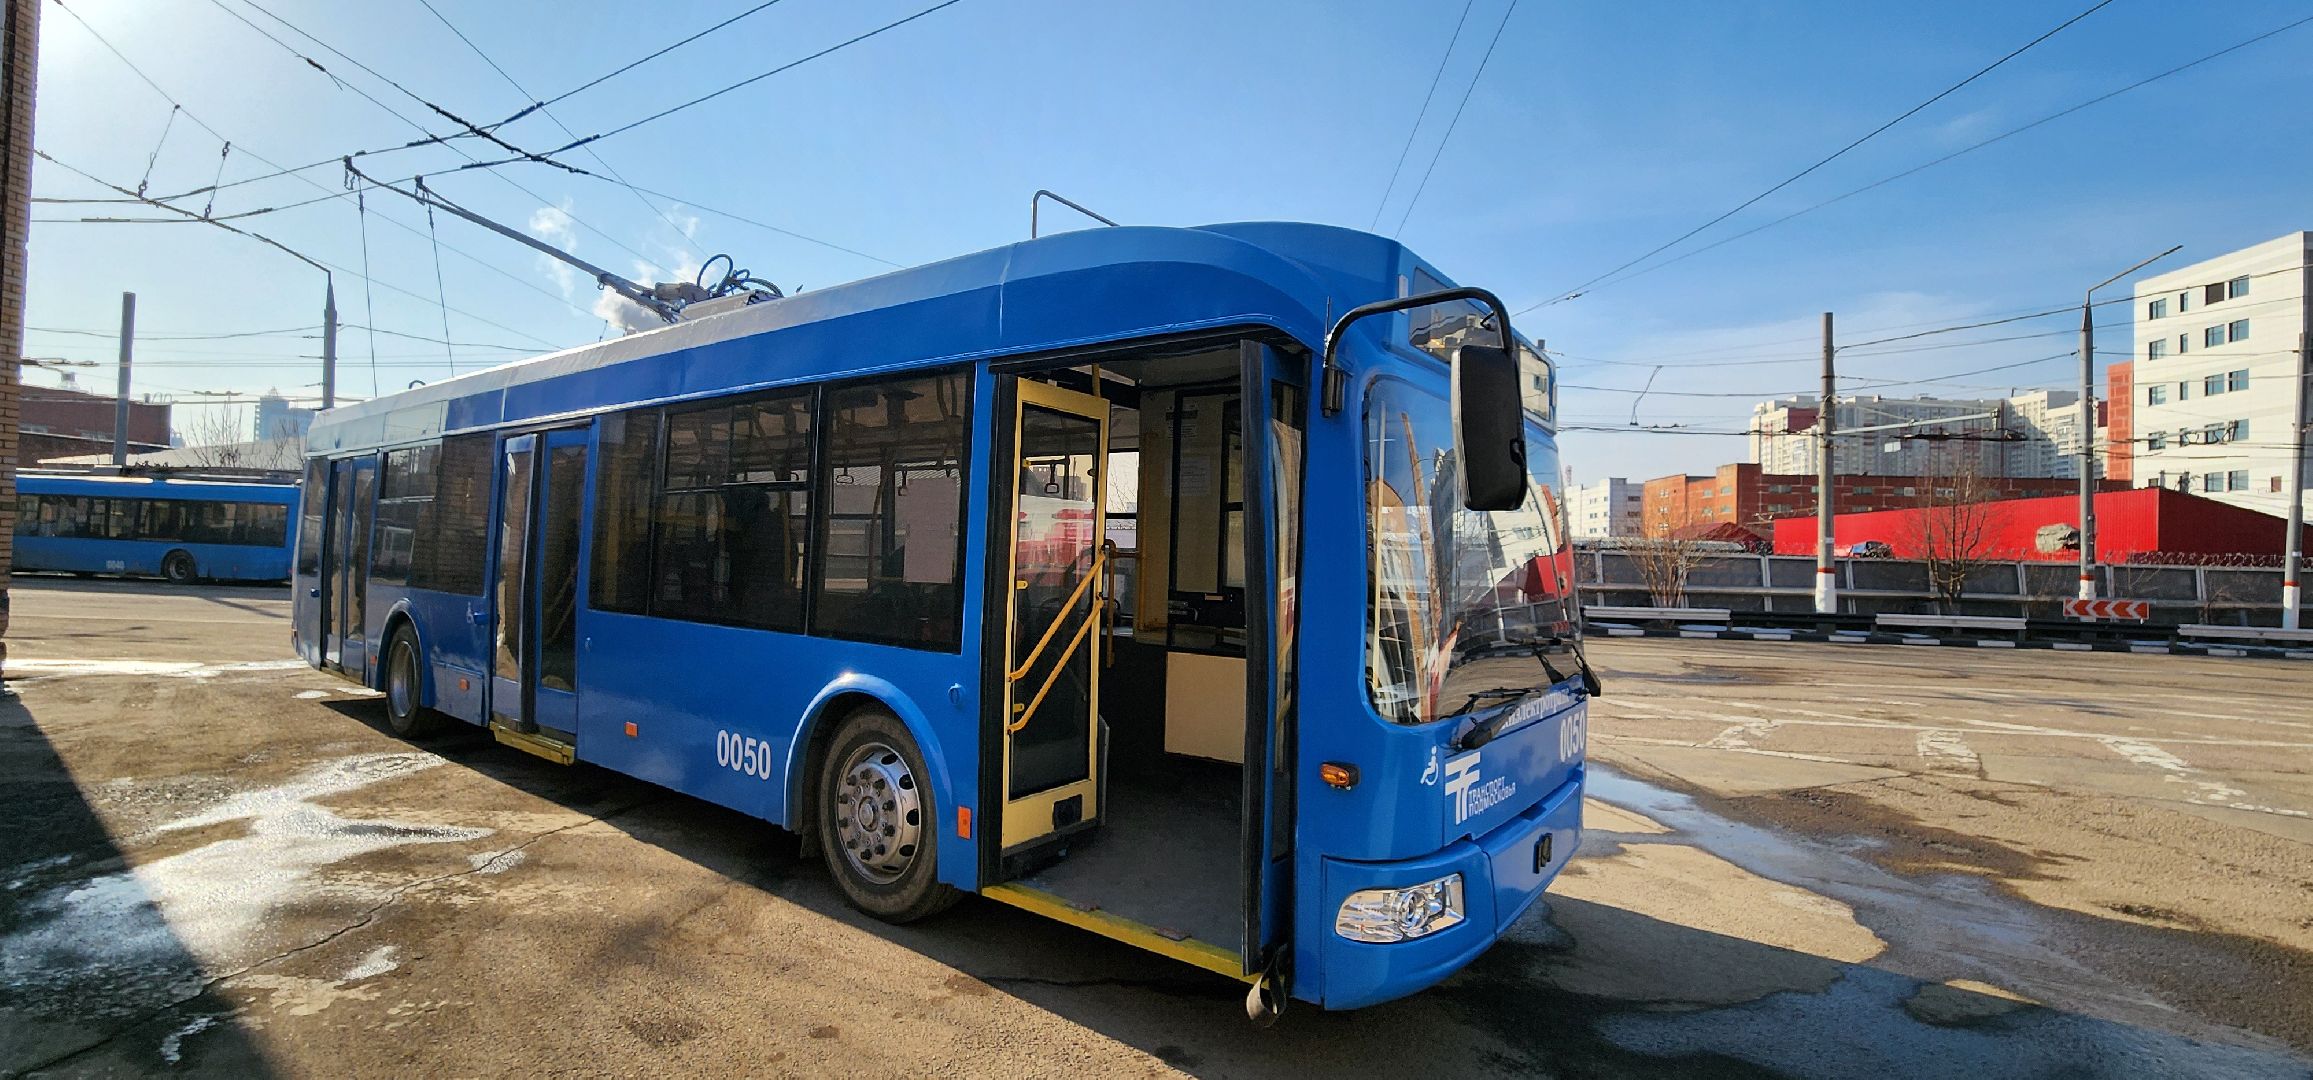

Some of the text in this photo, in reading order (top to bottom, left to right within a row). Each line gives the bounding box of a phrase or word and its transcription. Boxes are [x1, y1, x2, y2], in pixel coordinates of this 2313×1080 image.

[717, 729, 771, 780] 0050
[1560, 709, 1585, 762] 0050
[1468, 776, 1505, 804] ТРАНСПОРТ
[1468, 782, 1516, 817] ПОДМОСКОВЬЯ
